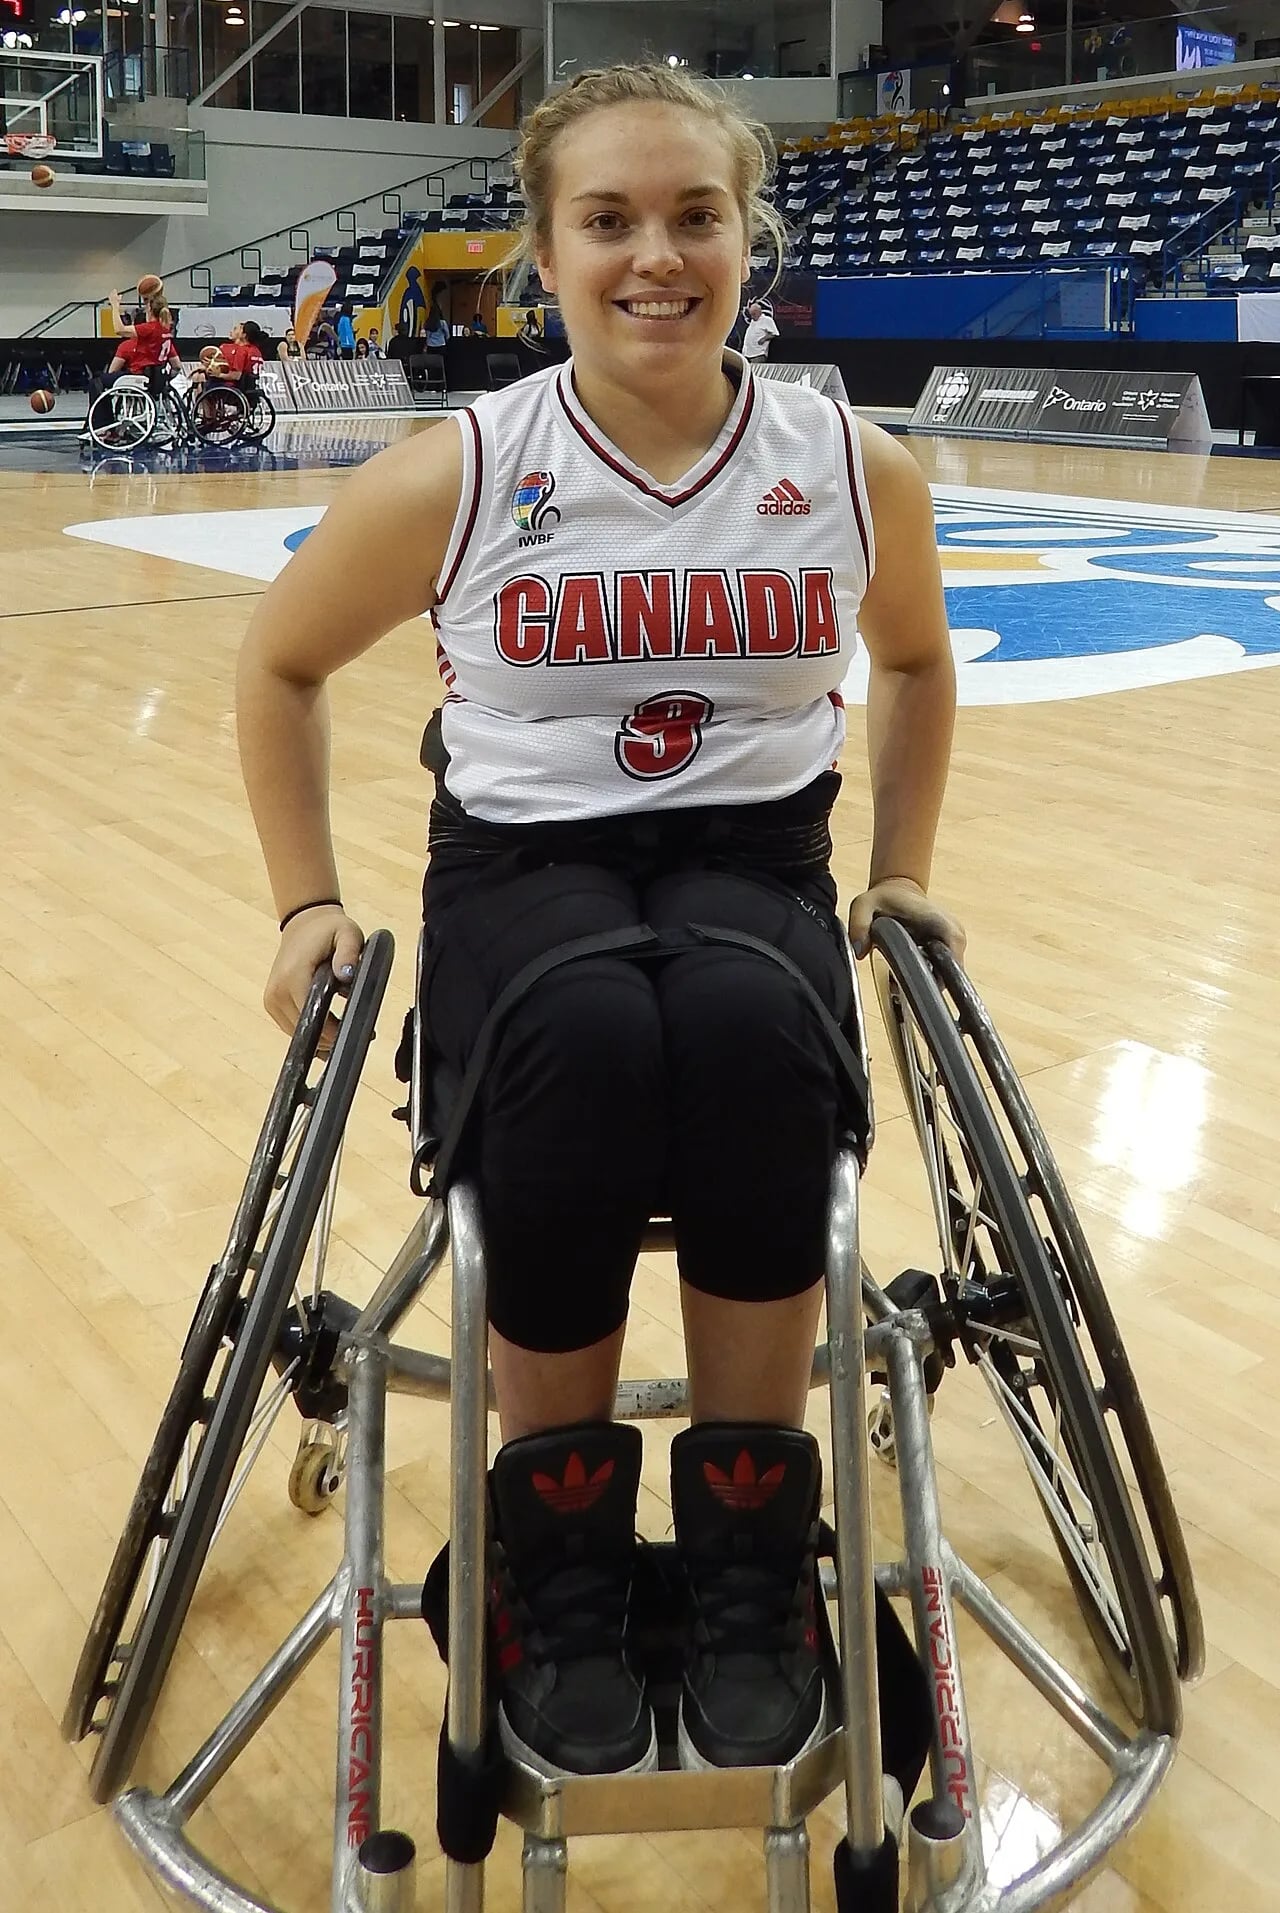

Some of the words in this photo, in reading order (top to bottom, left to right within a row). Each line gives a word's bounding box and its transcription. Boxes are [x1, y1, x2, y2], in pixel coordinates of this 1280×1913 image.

[311, 381, 349, 392] Ontario
[1063, 397, 1107, 412] Ontario
[756, 498, 811, 516] adidas
[518, 532, 555, 548] IWBF
[493, 567, 841, 668] CANADA
[614, 689, 714, 782] 3
[347, 1587, 375, 1850] HURRICANE
